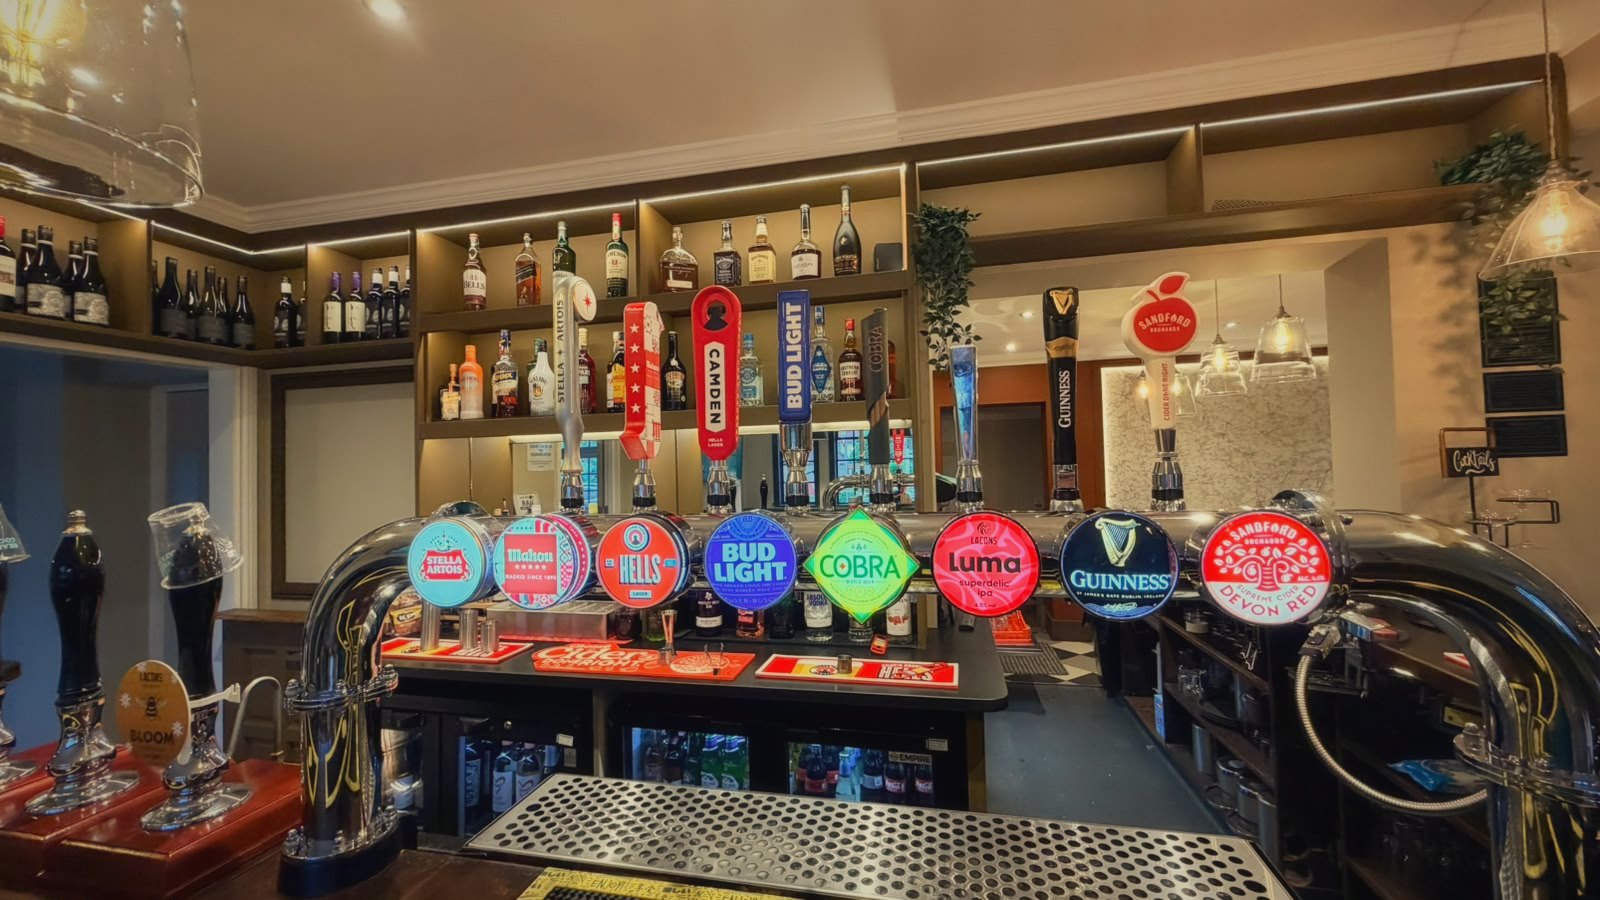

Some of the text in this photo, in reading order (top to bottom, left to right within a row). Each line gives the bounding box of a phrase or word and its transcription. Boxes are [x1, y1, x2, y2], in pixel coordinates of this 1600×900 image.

[1138, 312, 1192, 331] SANDFORD
[555, 299, 565, 404] STELLA ARTOIS
[785, 301, 803, 409] BUD LIGHT
[868, 325, 884, 373] COBRA
[708, 348, 722, 424] CAMDEN
[1058, 369, 1072, 429] GUINNESS
[970, 536, 998, 546] LACONS
[1230, 521, 1298, 542] SANDFORD
[426, 555, 463, 565] STELLA
[507, 548, 554, 563] Mahou
[722, 542, 776, 563] BUD
[949, 552, 1021, 573] Luma
[426, 565, 463, 574] ARTOIS
[619, 554, 662, 585] HELLS
[713, 561, 788, 583] LIGHT
[820, 554, 901, 579] COBRA
[959, 579, 1010, 589] superdelic
[1070, 569, 1169, 591] GUINNESS
[977, 590, 993, 598] ipa
[1220, 584, 1318, 617] DEVON RED
[1236, 584, 1300, 603] SUPREME CIDER
[538, 645, 648, 660] Cider
[130, 729, 175, 744] BLOOM
[900, 753, 931, 763] EMPIRE
